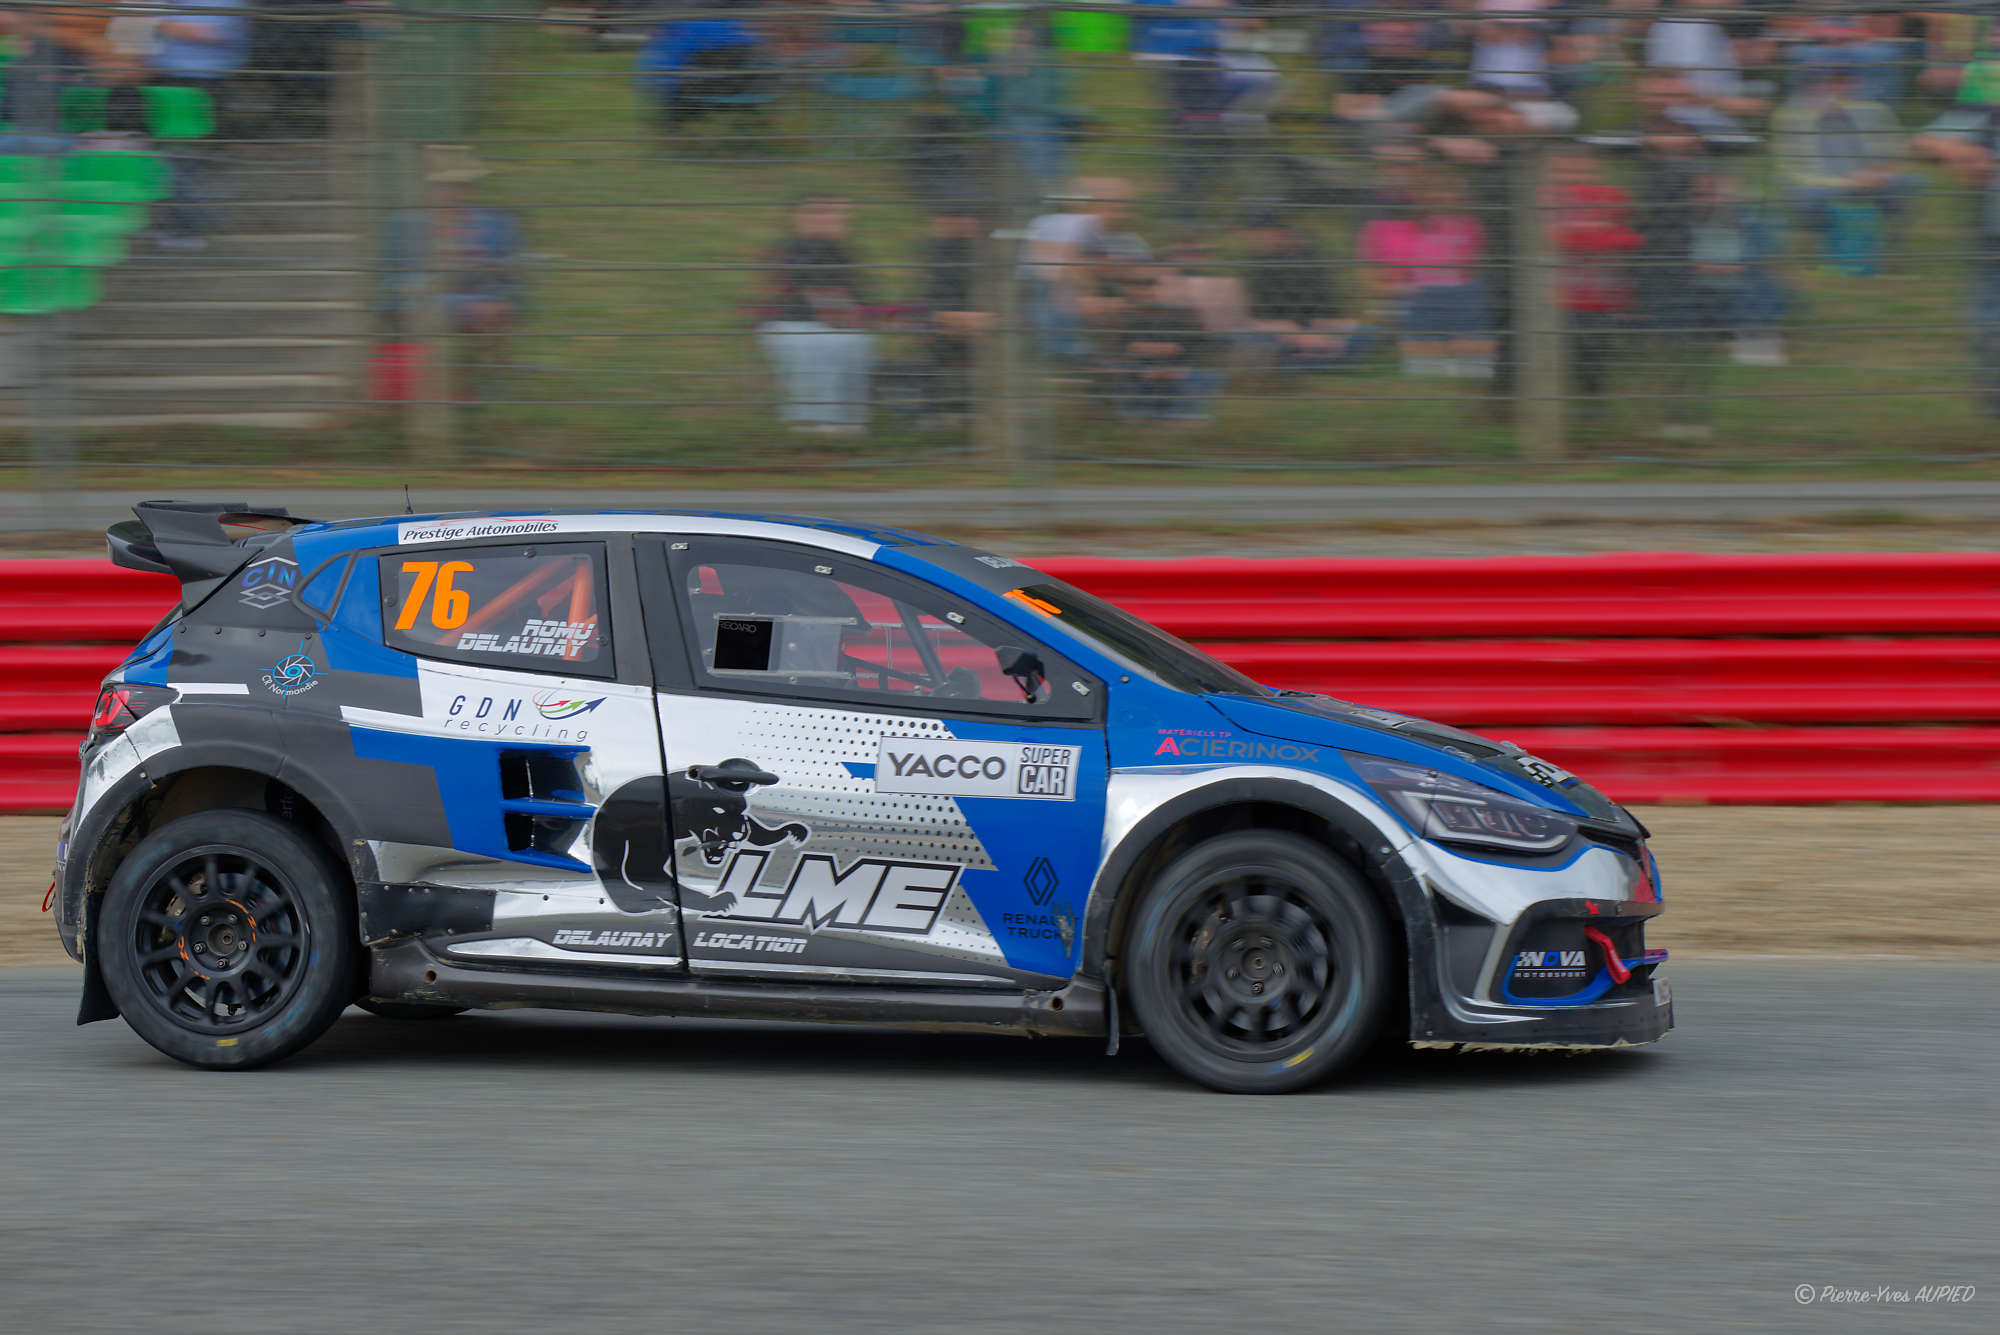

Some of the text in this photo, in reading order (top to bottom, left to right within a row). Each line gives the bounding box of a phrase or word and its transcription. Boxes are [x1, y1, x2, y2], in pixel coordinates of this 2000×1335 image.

[404, 522, 558, 541] Prestige Automobiles
[241, 562, 297, 588] CIN
[395, 560, 474, 630] 76
[521, 618, 595, 640] ROMU
[456, 632, 588, 657] DELAUNAY
[444, 718, 588, 742] recycling
[1020, 746, 1072, 765] SUPER
[1154, 736, 1320, 762] ACIERINOX
[887, 752, 1006, 780] YACCO
[1020, 766, 1066, 795] CAR
[698, 849, 966, 936] LME
[553, 929, 808, 953] DELAUNAY LOCATION
